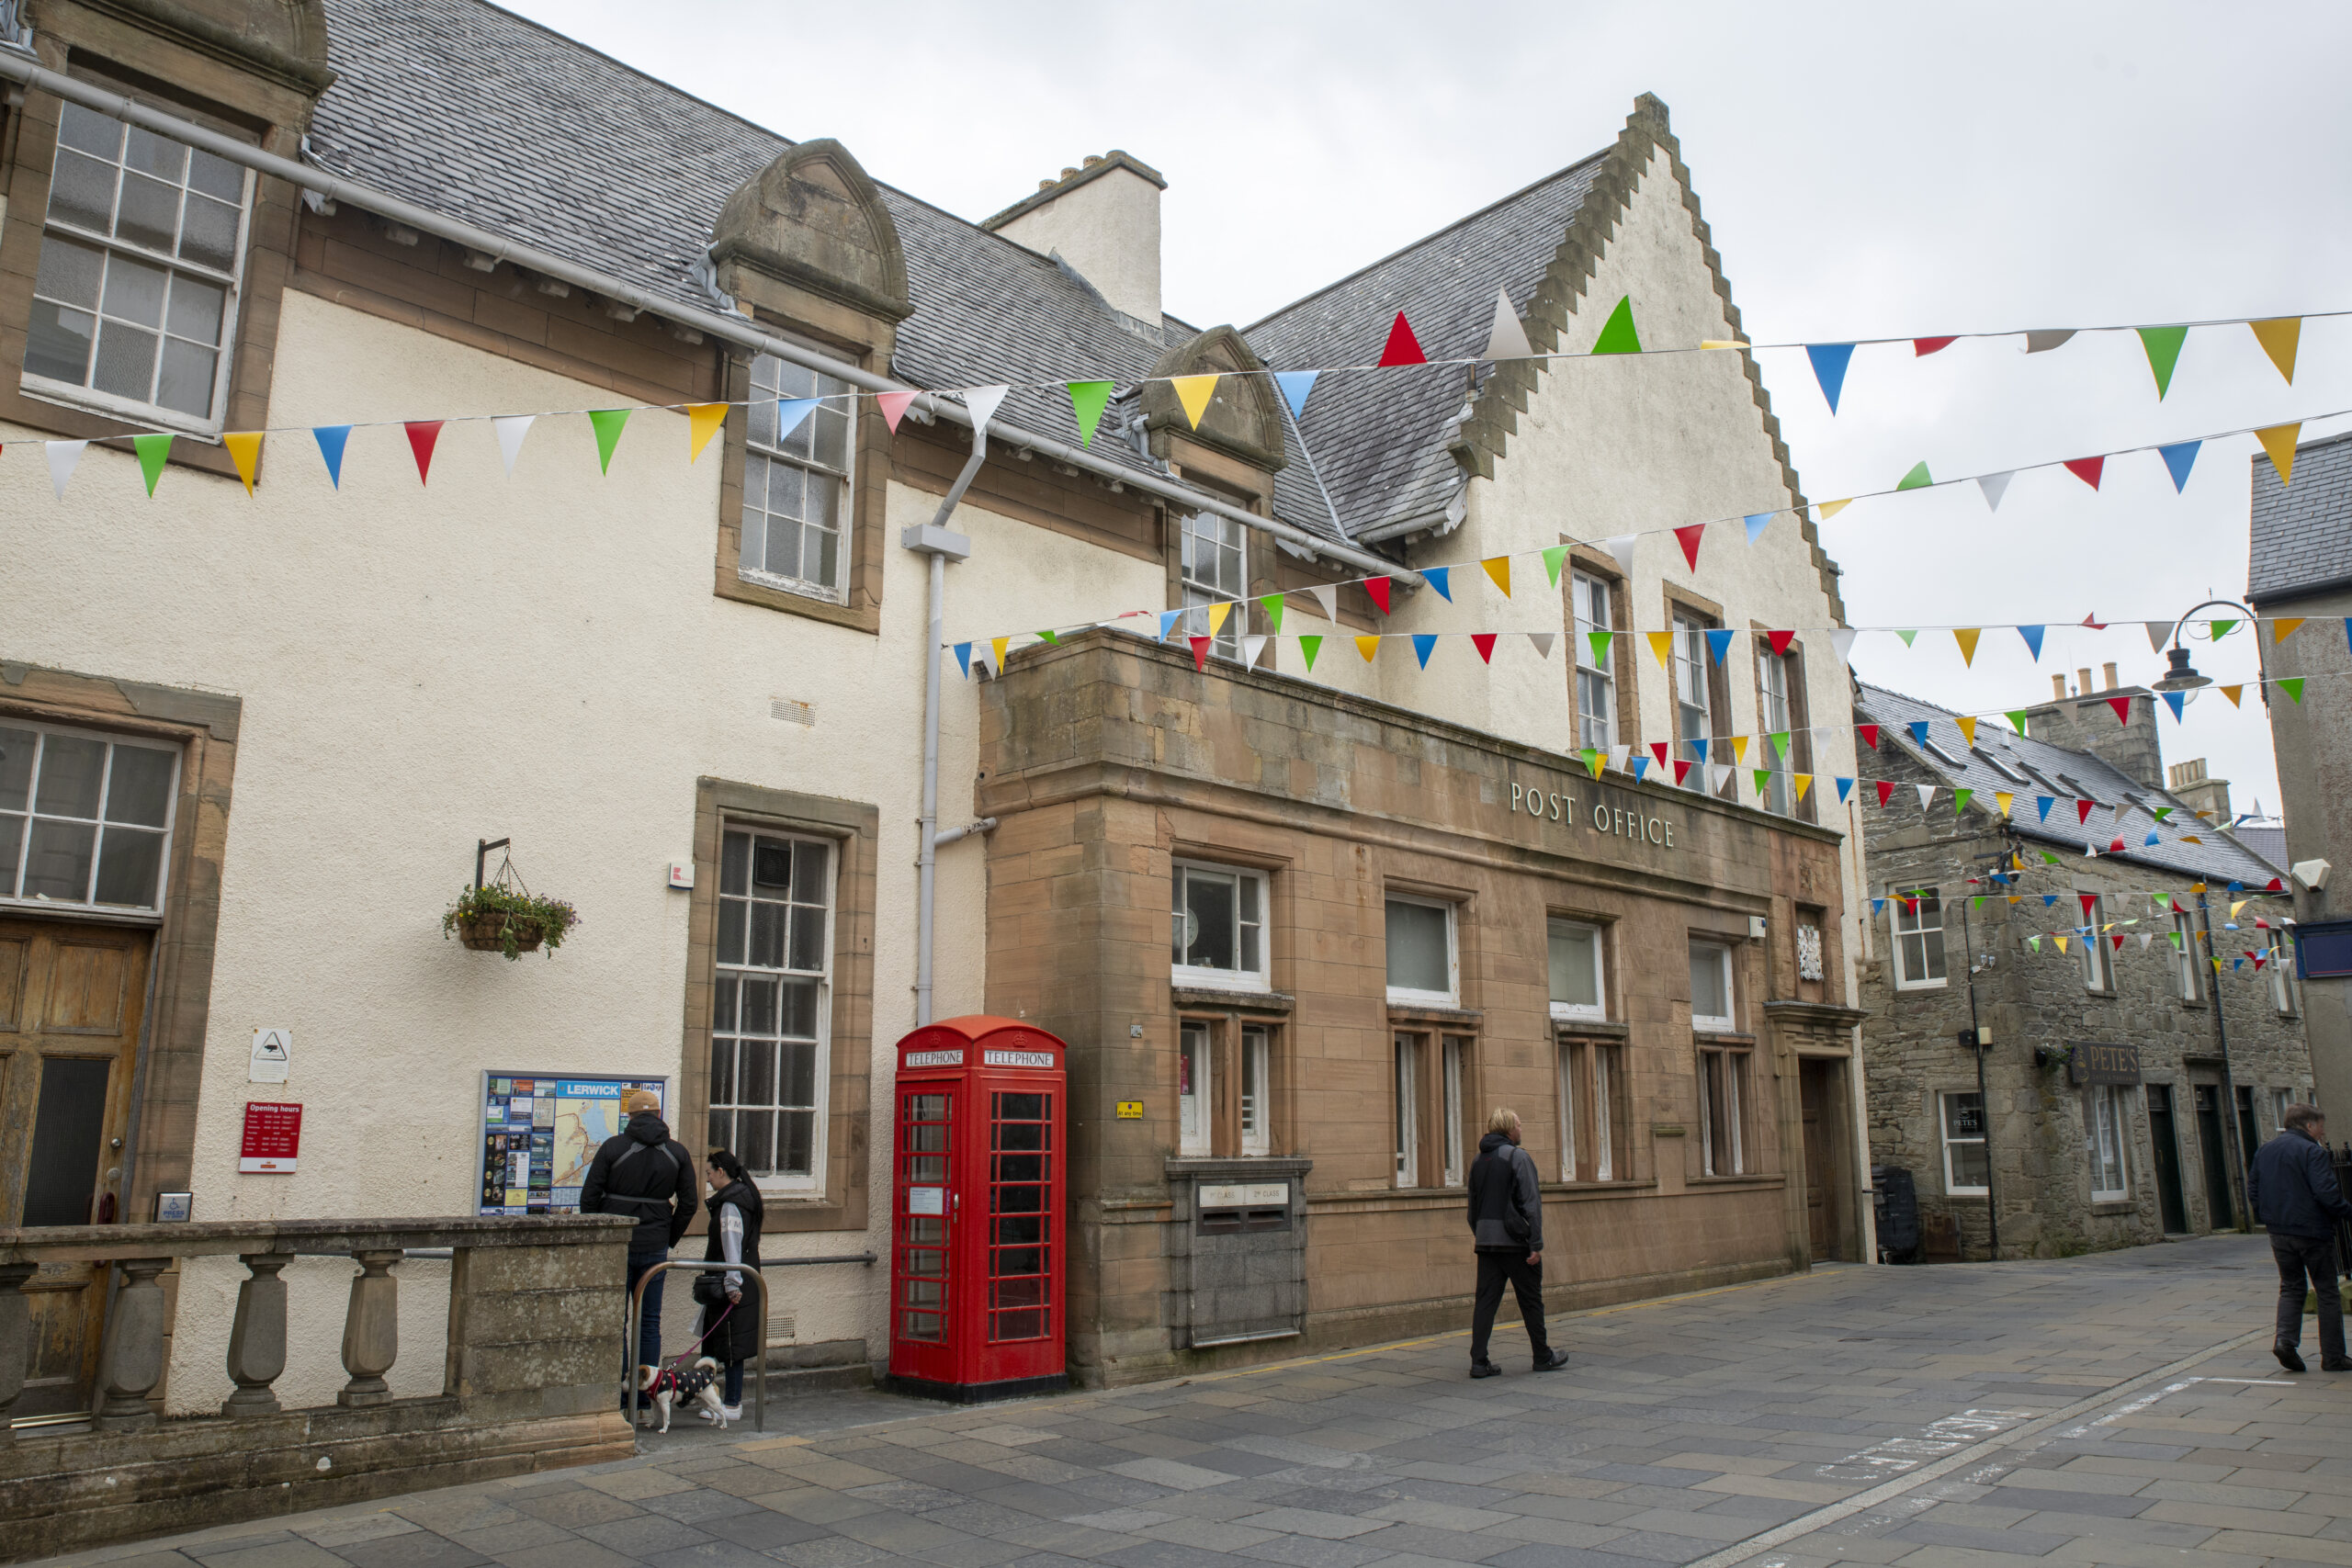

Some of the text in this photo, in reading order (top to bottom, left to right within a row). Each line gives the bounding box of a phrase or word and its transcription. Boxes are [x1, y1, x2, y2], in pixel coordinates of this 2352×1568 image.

[1511, 783, 1674, 847] POST OFFICE
[909, 1051, 962, 1066] TELEPHONE
[986, 1051, 1052, 1066] TELEPHONE
[2090, 1046, 2137, 1073] PETE'S
[567, 1084, 619, 1096] LERWICK
[250, 1104, 278, 1113] Opening
[1262, 1190, 1280, 1198] CLASS
